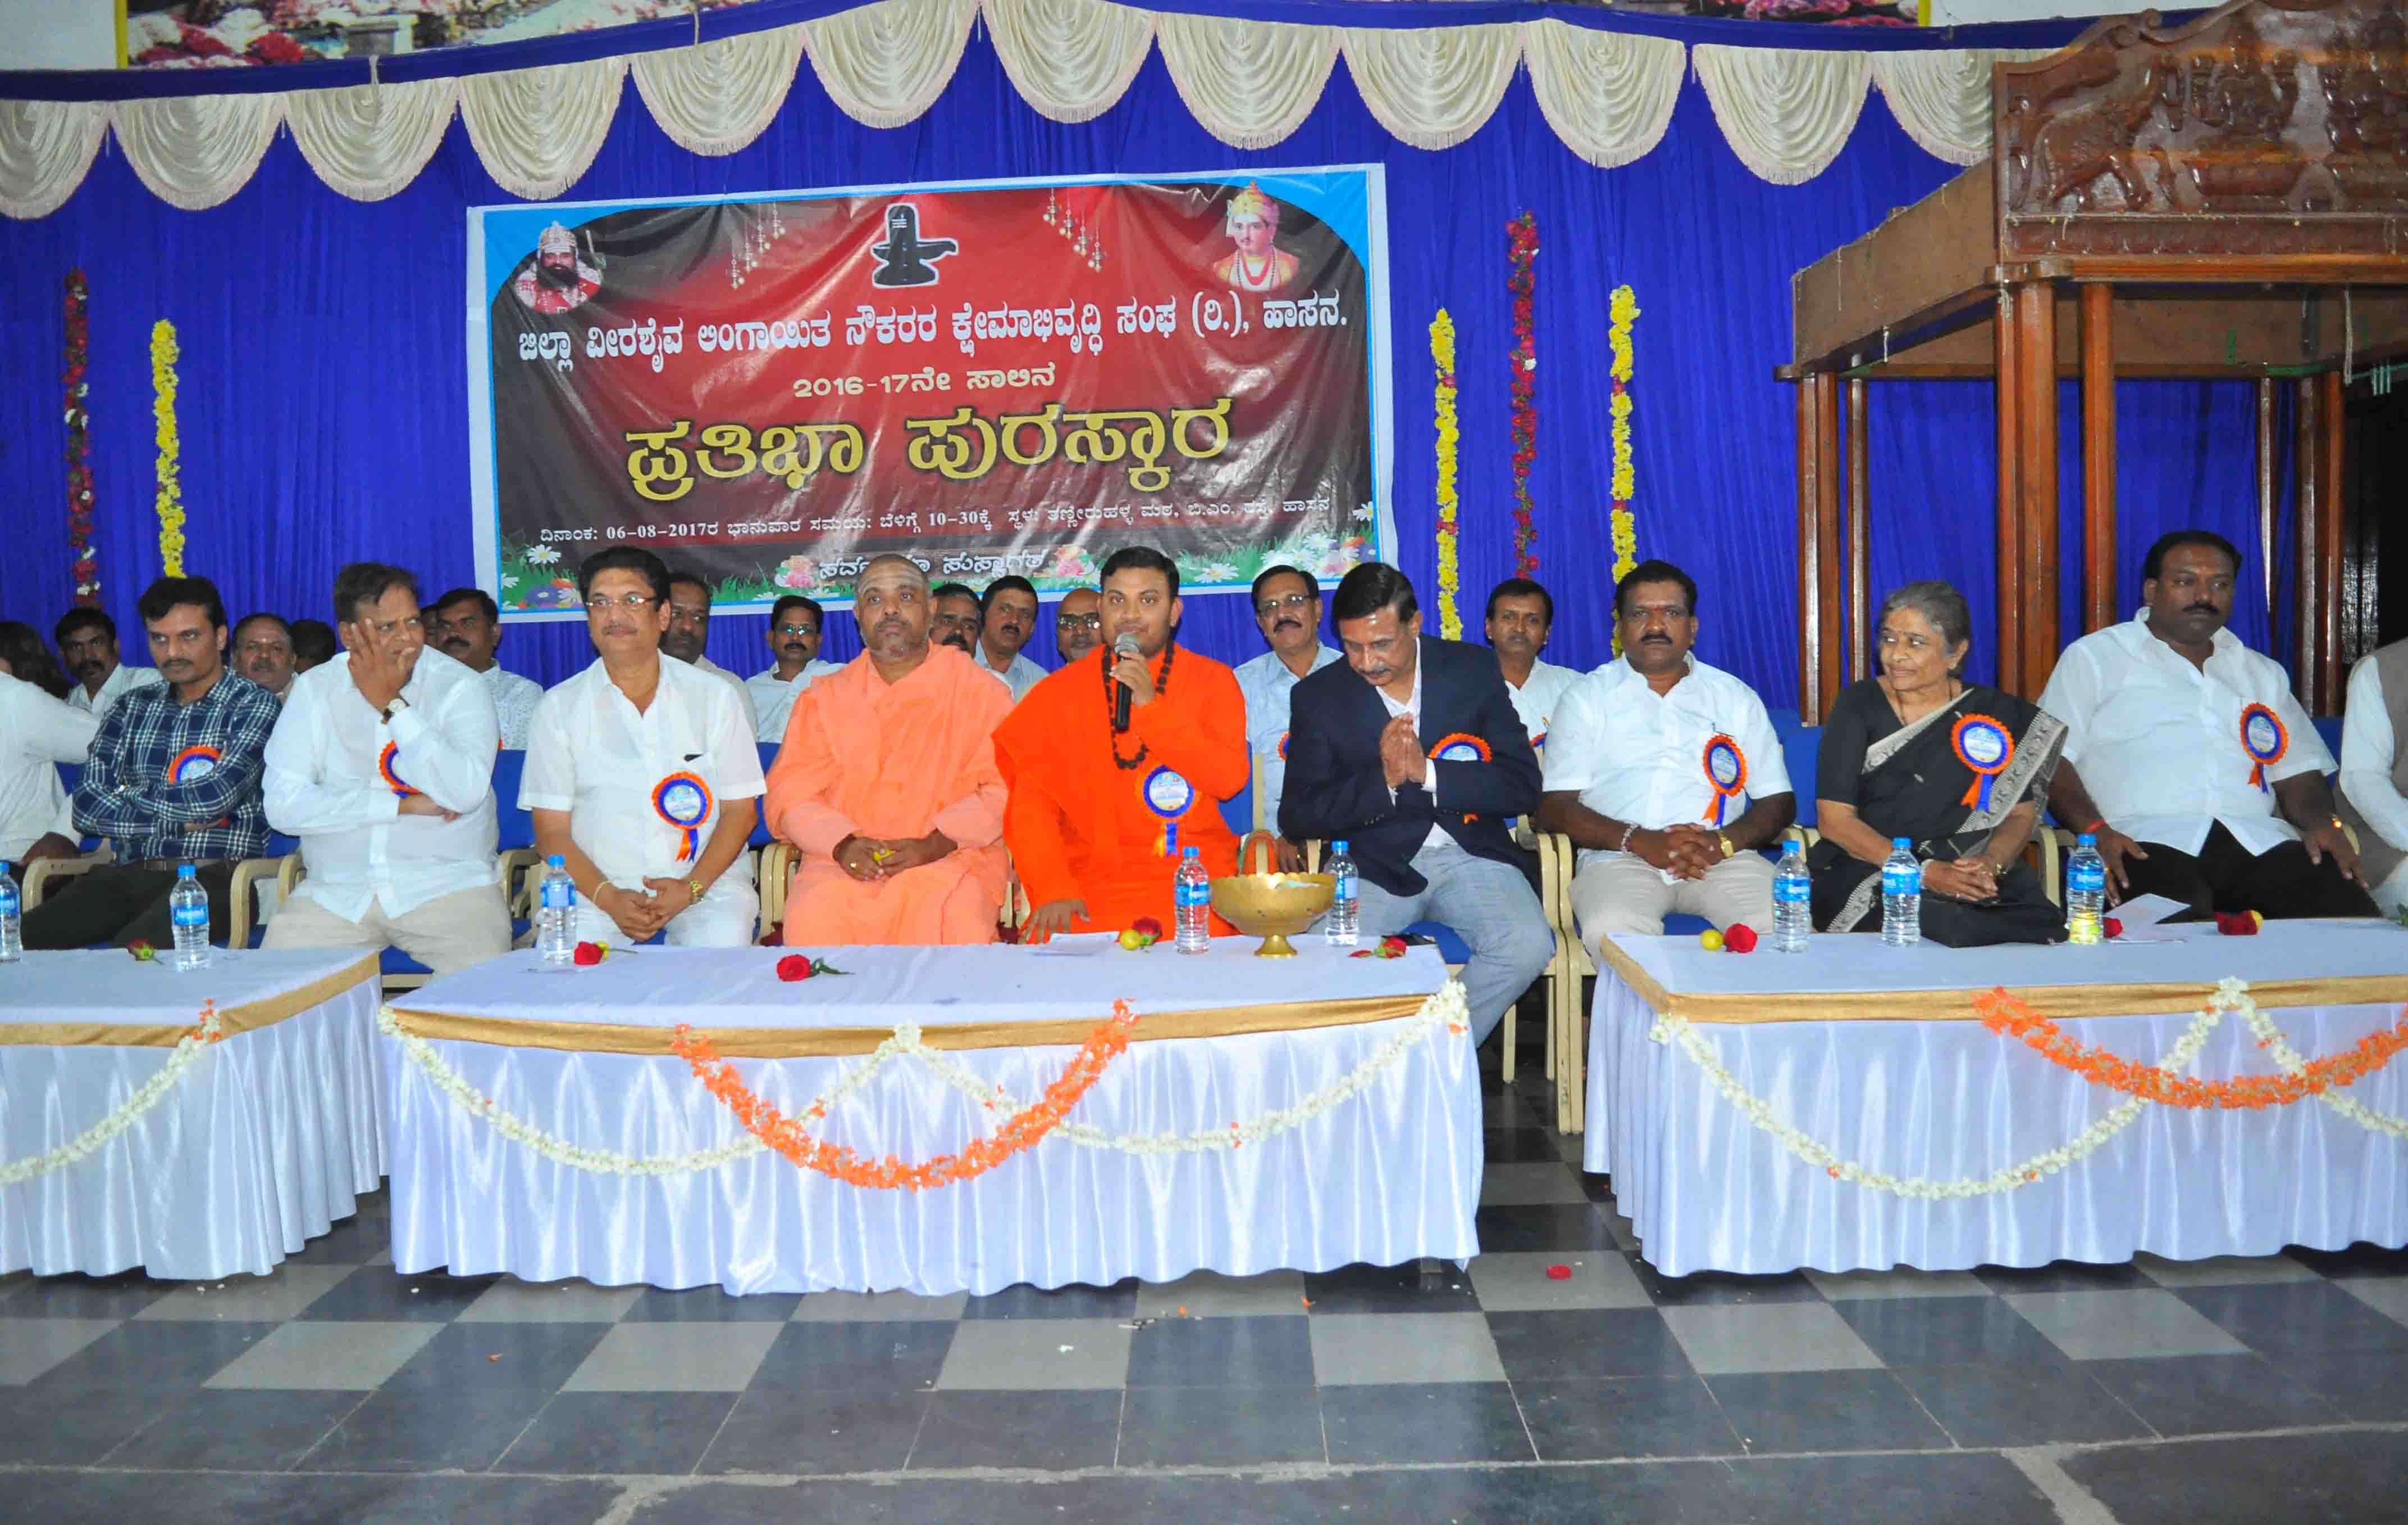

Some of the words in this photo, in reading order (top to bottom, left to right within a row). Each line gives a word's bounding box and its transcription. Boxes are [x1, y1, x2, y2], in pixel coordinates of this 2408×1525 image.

[518, 330, 573, 372] ಜಿಲ್ಲಾ
[586, 316, 684, 373] ವೀರಶೈವ
[697, 310, 831, 352] ಲಿಂಗಾಯಿತ
[846, 304, 937, 346] ನೌಕರರ
[952, 298, 1103, 357] ಕ್ಷೇಮಾಭಿವೃದ್ಧಿ
[1117, 295, 1176, 338] ಸಂಘ
[1192, 290, 1249, 337] (ರಿ.),
[1262, 287, 1347, 329] ಹಾಸನ.
[793, 366, 951, 398] 2016-17ನೇ
[966, 361, 1056, 391] ಸಾಲಿನ
[626, 421, 864, 501] ಪ್ರತಿಭಾ
[906, 398, 1232, 492] ಪುರಸ್ಕಾರ
[540, 527, 598, 542] ದಿನಾಂಕ:
[728, 518, 801, 537] ಭಾನುವಾರ
